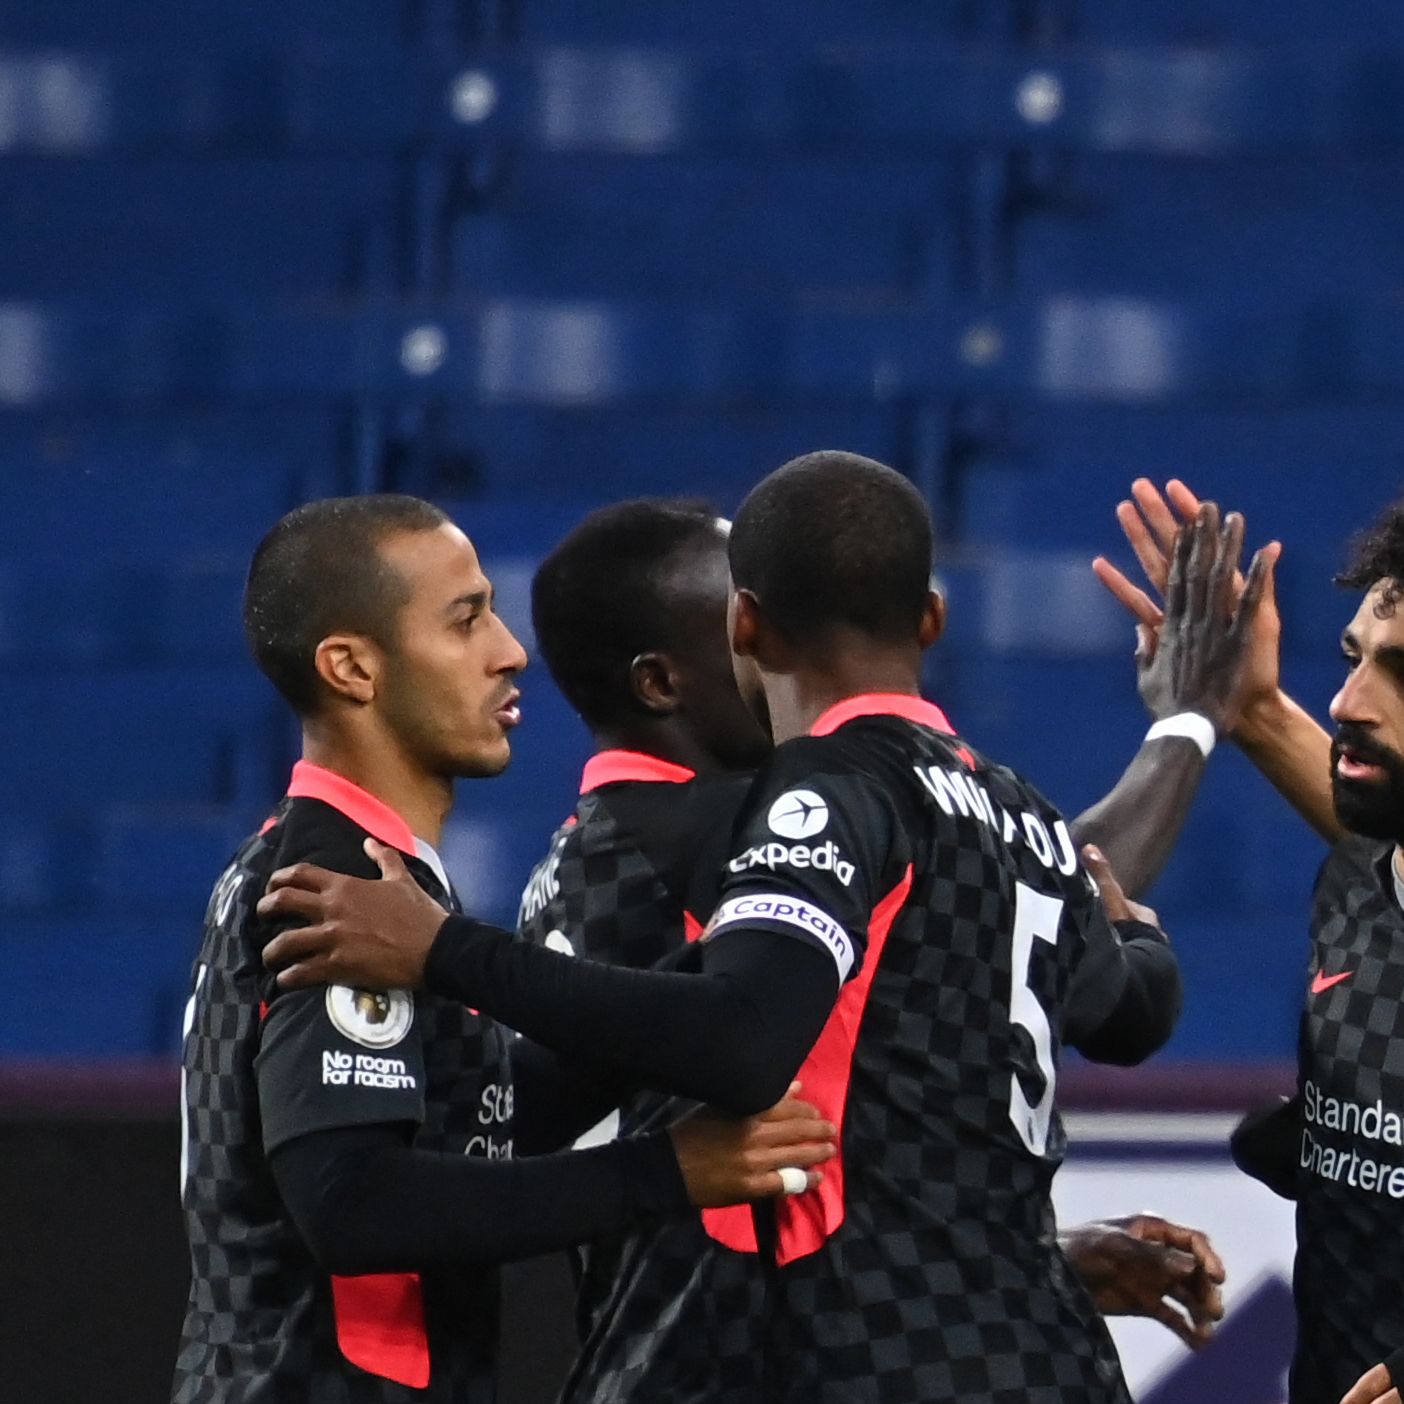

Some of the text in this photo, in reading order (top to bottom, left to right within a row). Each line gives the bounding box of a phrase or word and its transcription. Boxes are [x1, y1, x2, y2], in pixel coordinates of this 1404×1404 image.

[728, 841, 856, 886] Expedia
[322, 1051, 405, 1076] No room
[354, 1070, 416, 1089] racism
